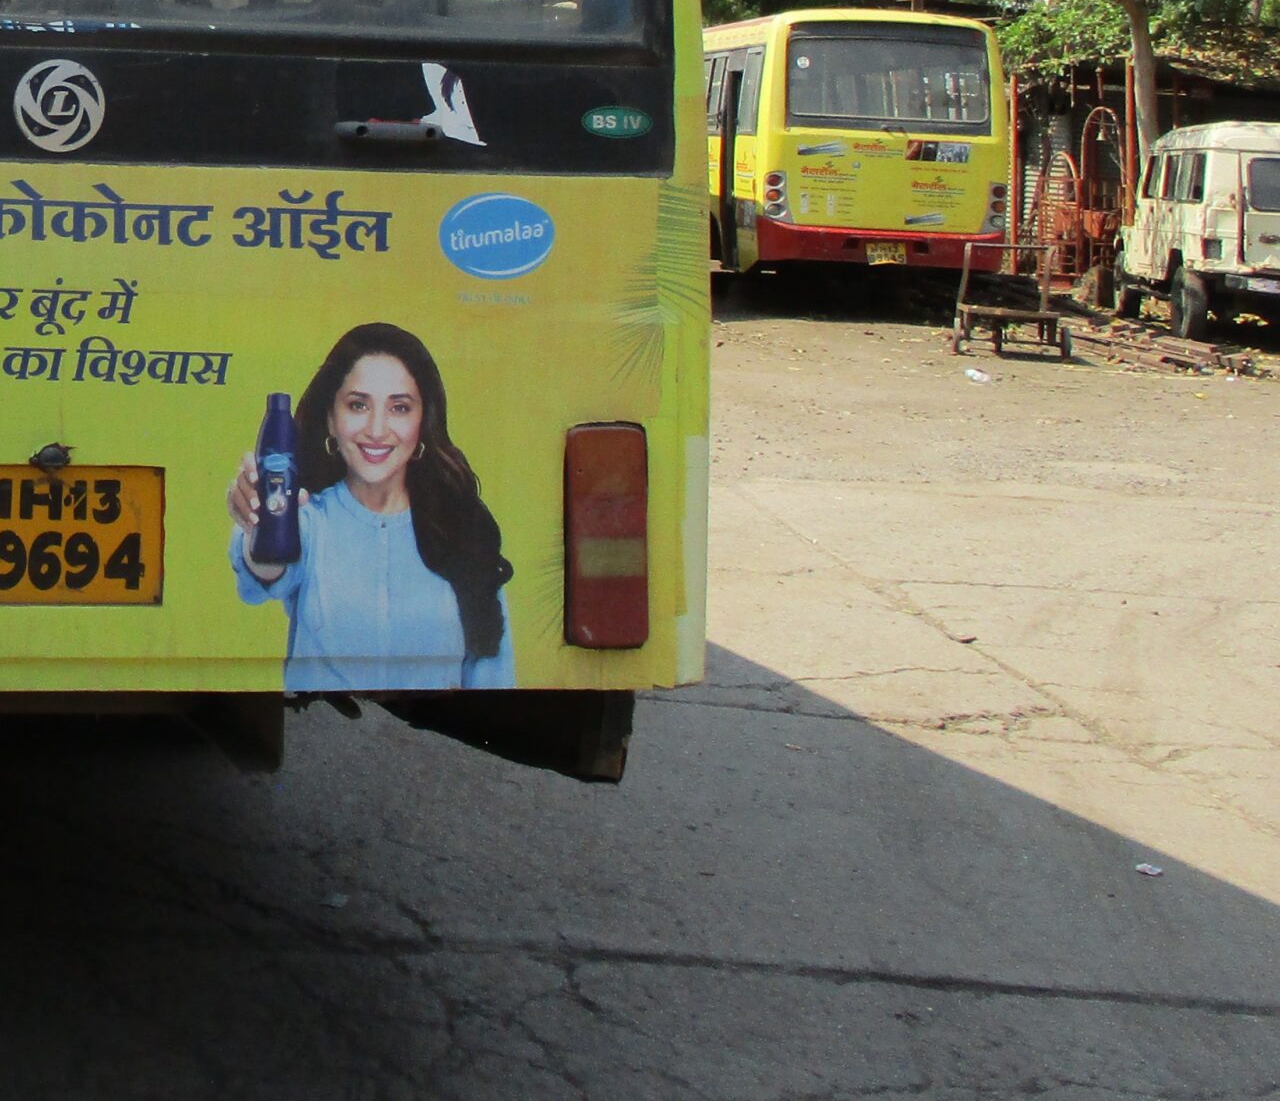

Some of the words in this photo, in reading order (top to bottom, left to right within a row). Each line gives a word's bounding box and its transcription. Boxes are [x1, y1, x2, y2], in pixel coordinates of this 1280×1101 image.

[47, 90, 77, 116] L
[592, 114, 617, 129] BS
[623, 114, 644, 129] IV
[232, 188, 393, 260] ऑईल
[450, 221, 545, 251] tirumalaa
[29, 277, 93, 336] बूंद
[98, 277, 139, 325] में
[2, 346, 67, 381] का
[72, 335, 234, 387] विश्वास
